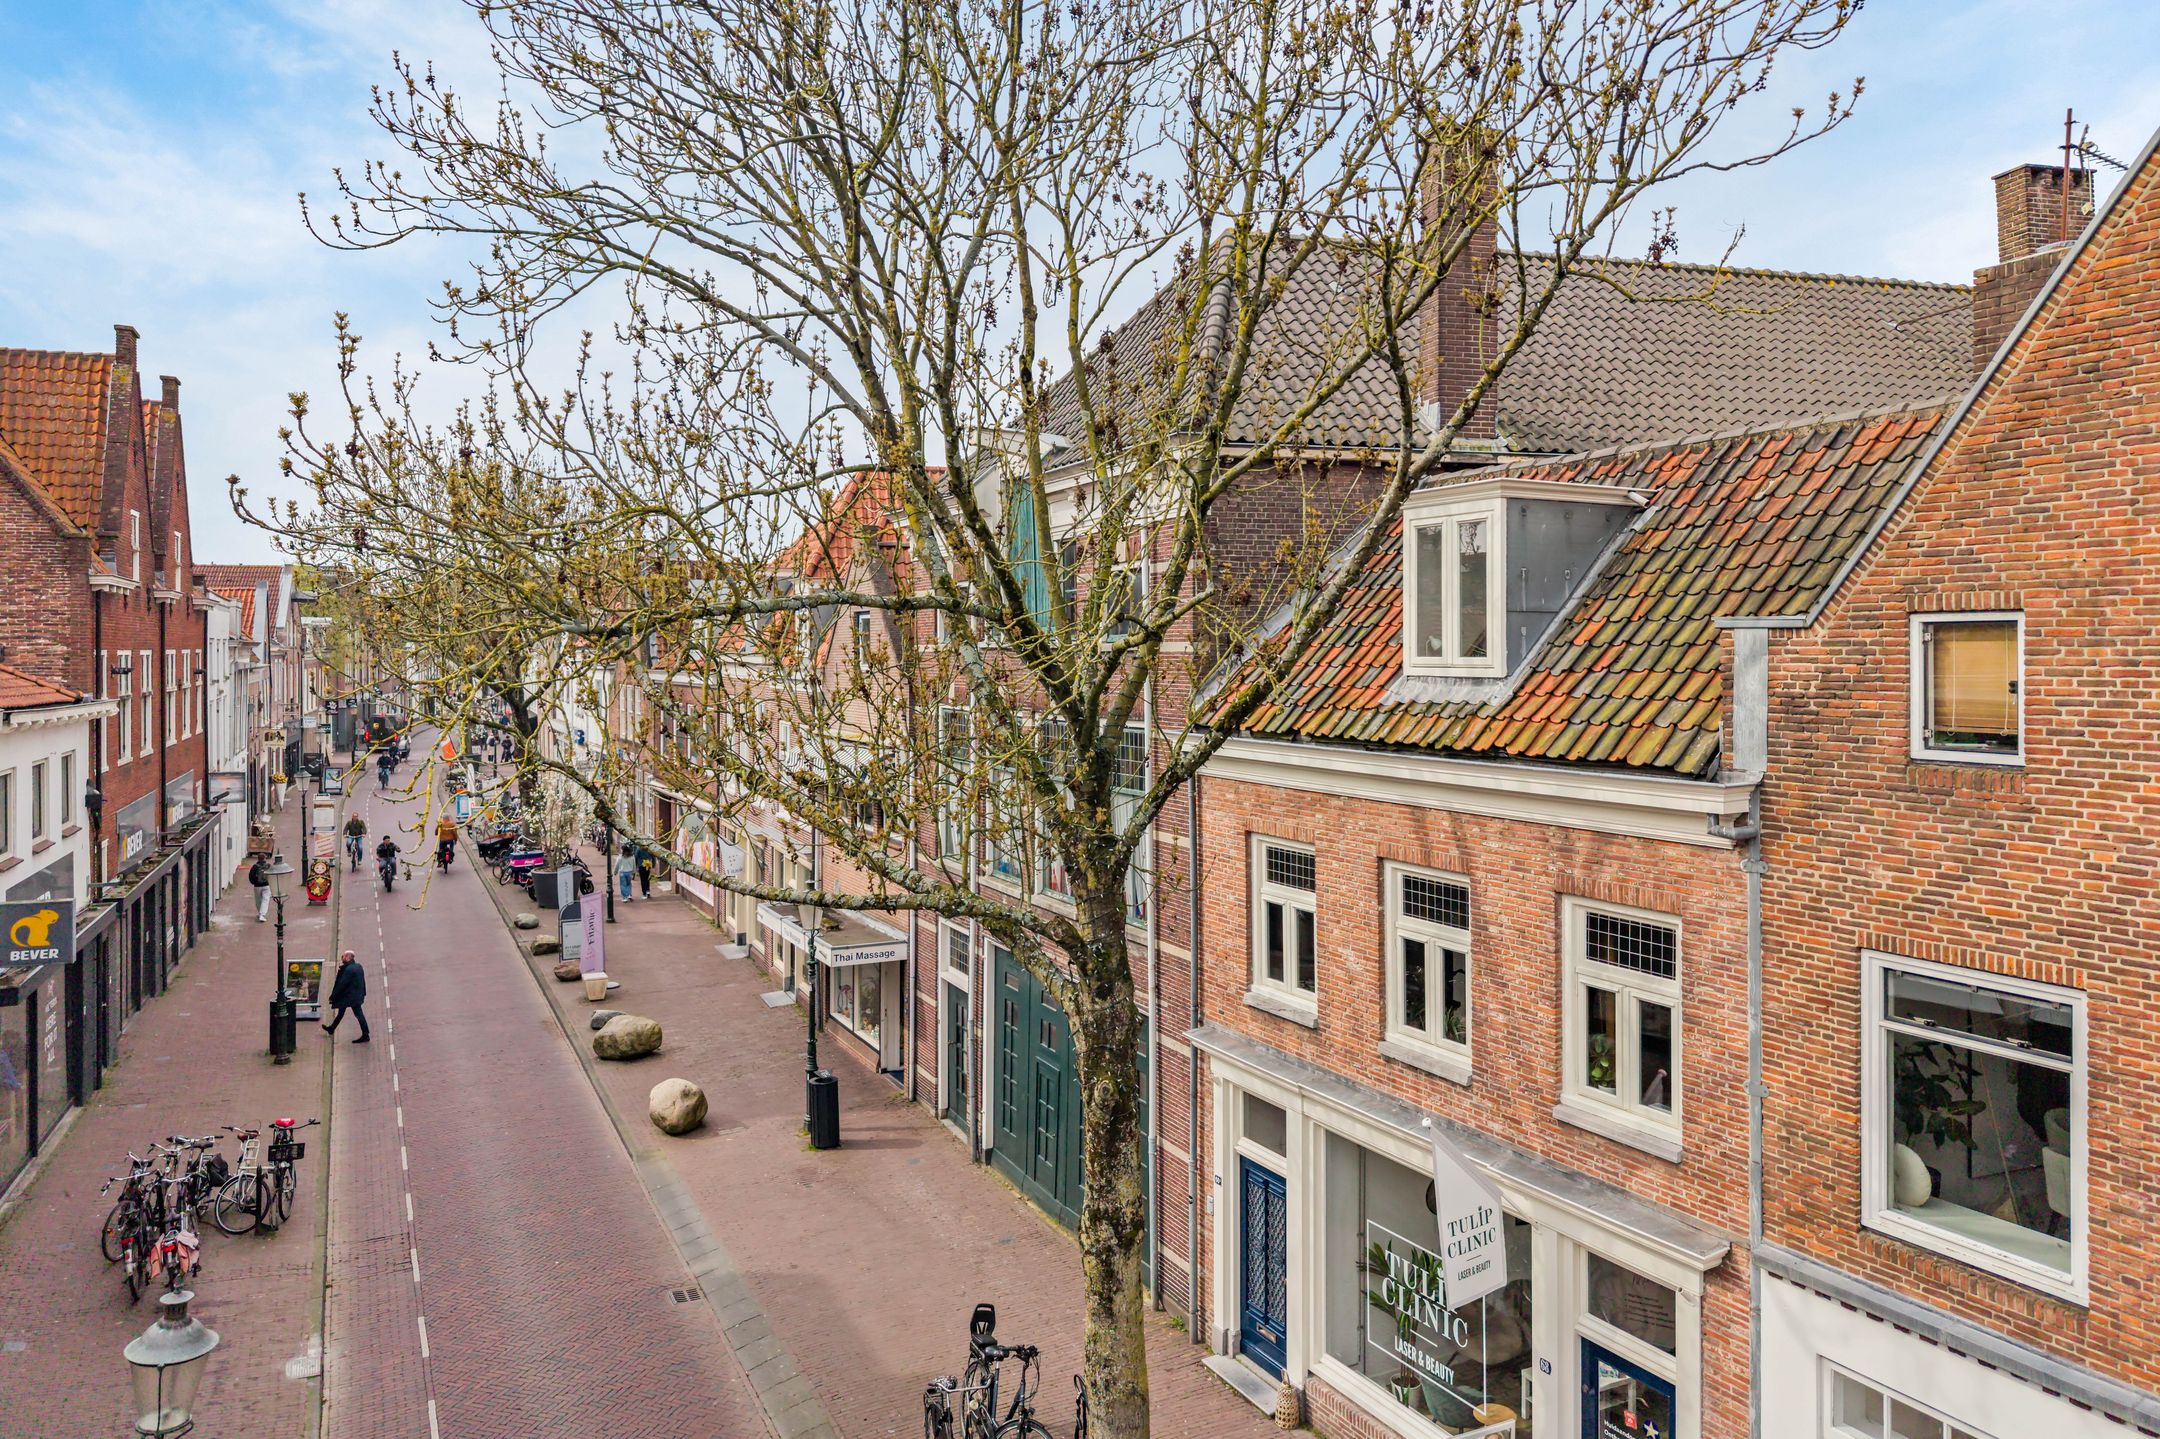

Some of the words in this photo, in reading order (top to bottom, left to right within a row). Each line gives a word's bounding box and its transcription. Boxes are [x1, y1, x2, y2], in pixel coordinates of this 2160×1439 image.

[10, 948, 59, 961] BEVER
[834, 952, 853, 962] Thai
[855, 950, 895, 961] Massage
[1447, 1227, 1497, 1259] CLINIC
[1385, 1249, 1457, 1315] TULI
[1457, 1267, 1471, 1281] LASER
[1475, 1260, 1491, 1275] BEAUTY
[1382, 1277, 1469, 1348] CLINIC
[1394, 1335, 1418, 1364] LASER
[1417, 1351, 1426, 1368] &
[1425, 1353, 1455, 1386] BEAUTY
